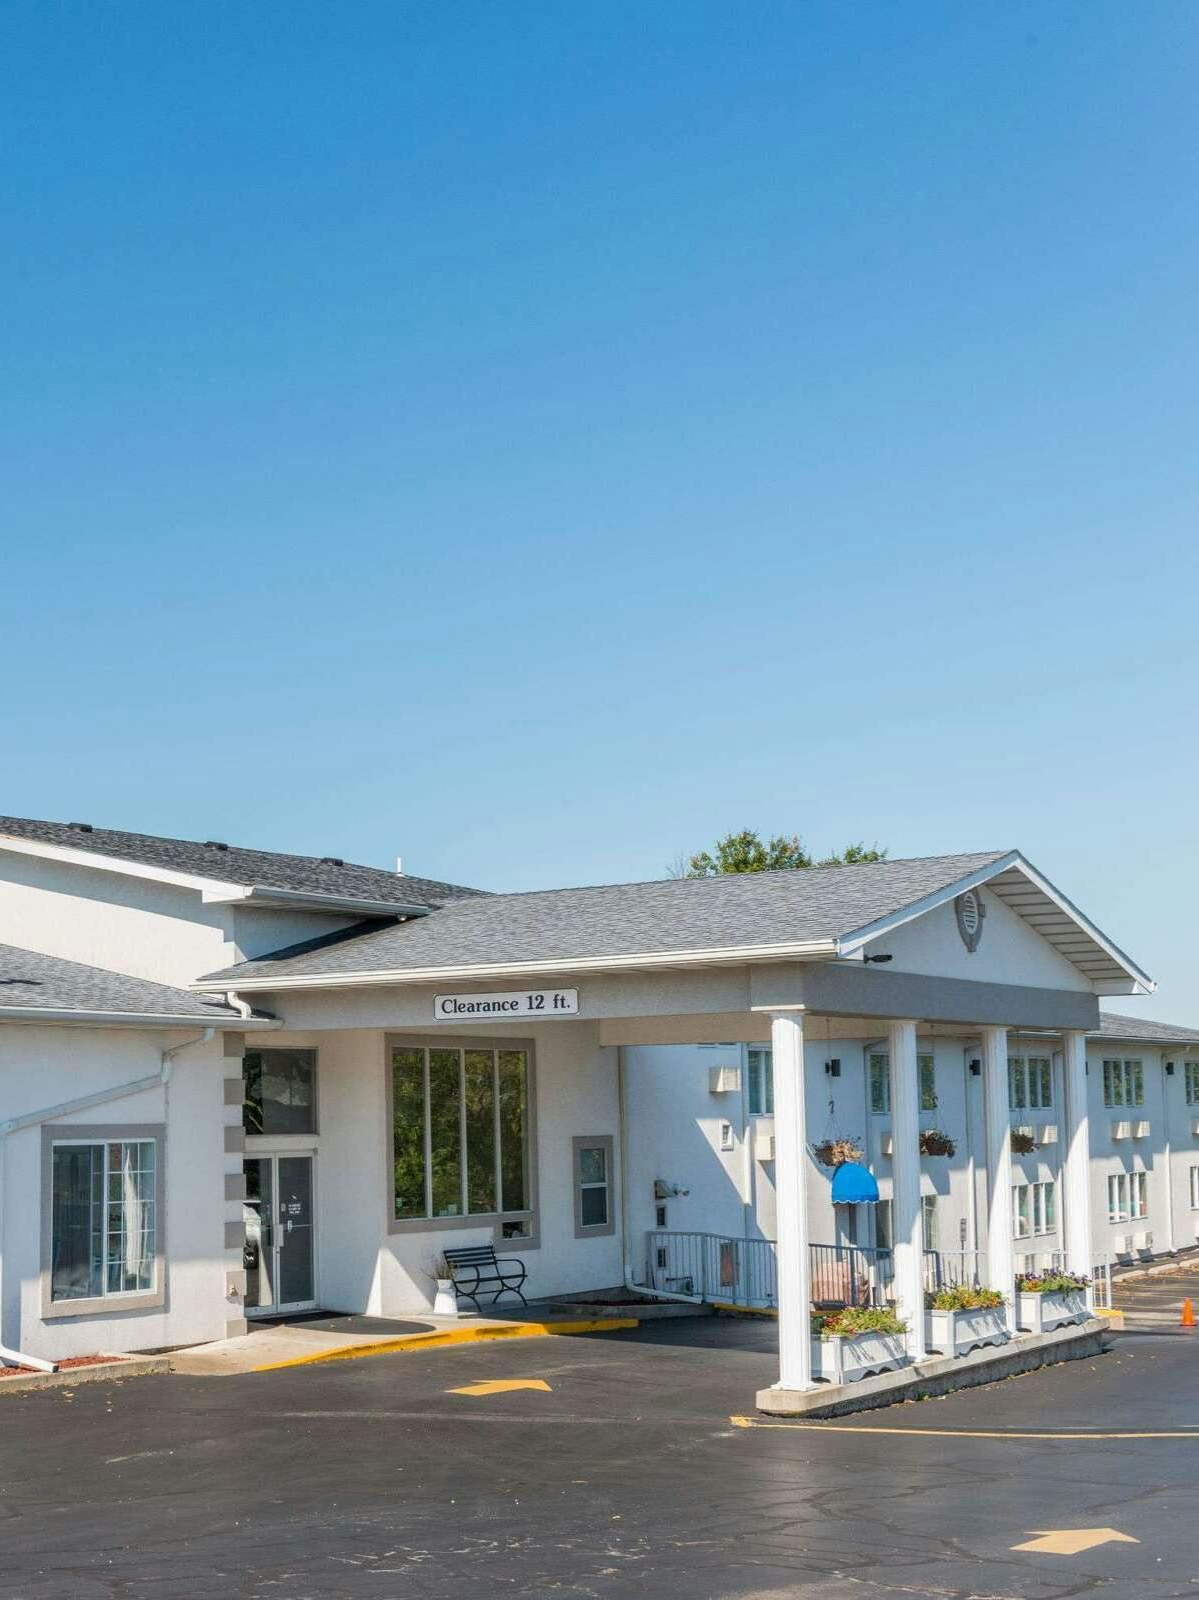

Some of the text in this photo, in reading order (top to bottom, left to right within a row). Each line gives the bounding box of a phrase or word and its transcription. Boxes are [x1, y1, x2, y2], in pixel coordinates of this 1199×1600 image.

[441, 993, 571, 1014] Clearance 12 ft.
